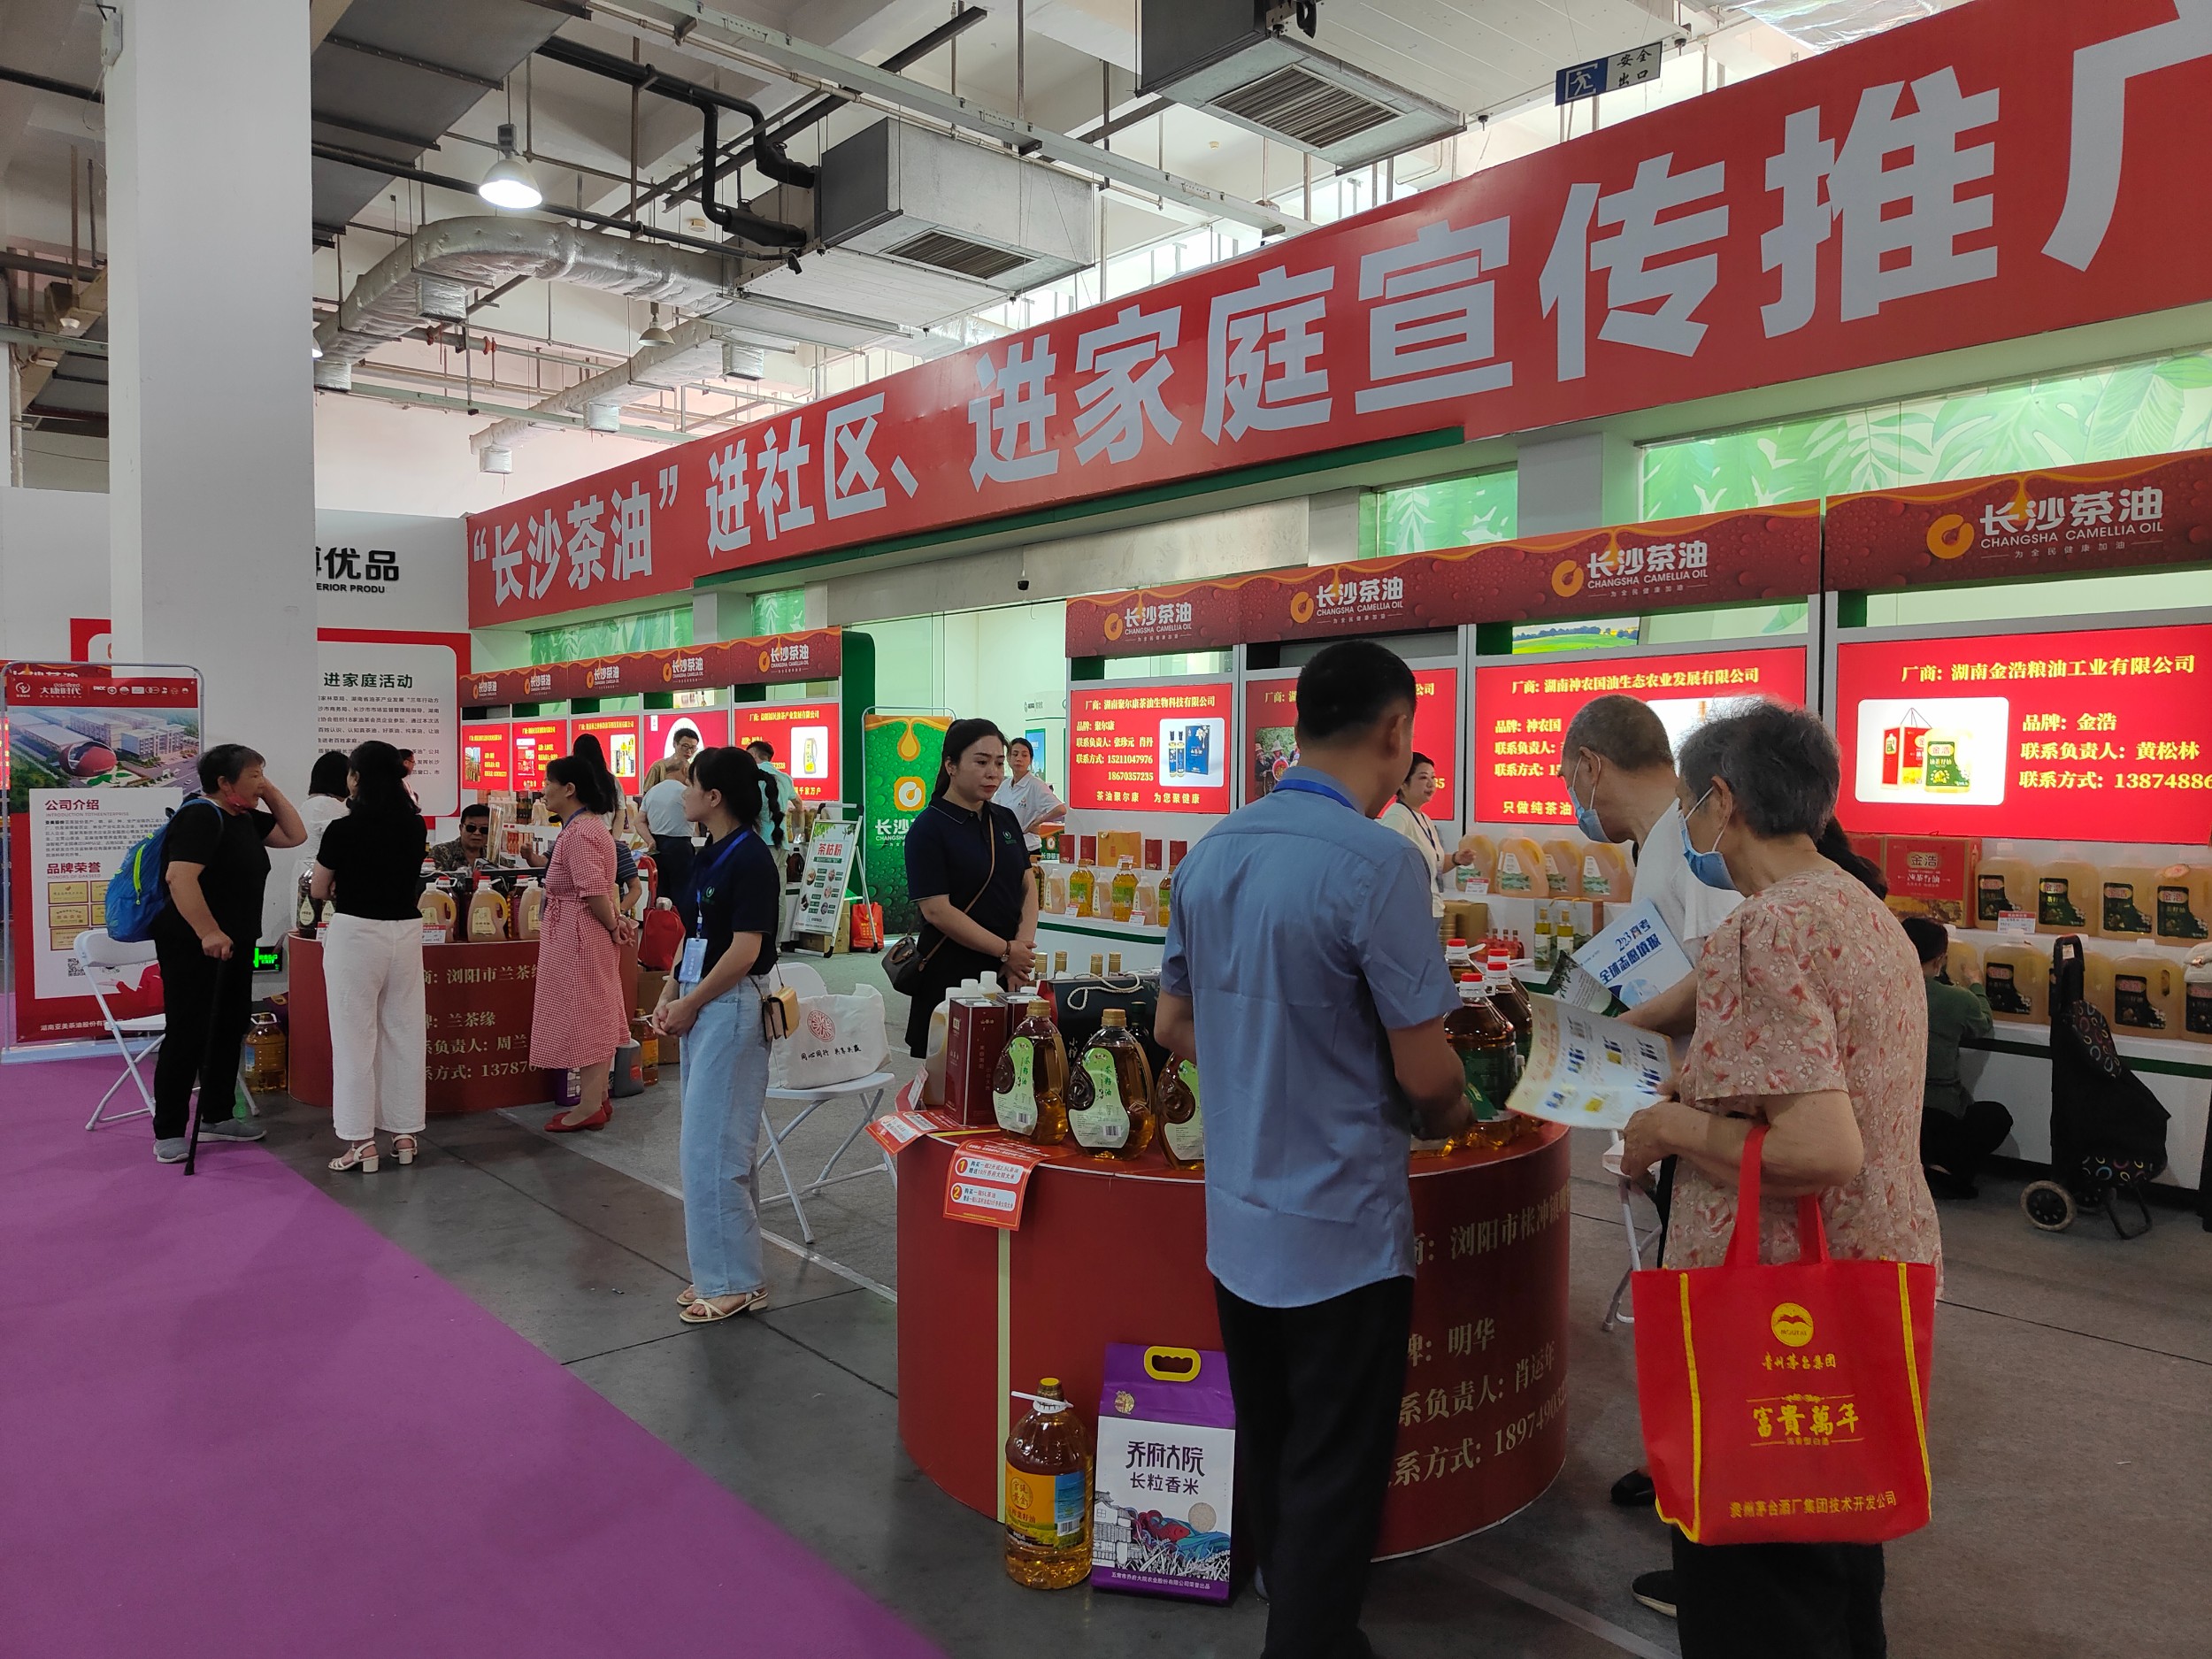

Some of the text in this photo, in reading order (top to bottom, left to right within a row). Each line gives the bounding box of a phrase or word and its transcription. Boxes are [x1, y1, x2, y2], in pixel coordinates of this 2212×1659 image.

[1617, 49, 1652, 67] 安全
[1618, 70, 1648, 87] 出口
[1980, 486, 2163, 535] 长沙茶油
[1981, 522, 2163, 549] CHANGSHA CAMELLIA OIL
[2015, 541, 2124, 557] 为全民健康加油
[1587, 541, 1708, 580] 长沙茶油
[1587, 569, 1708, 588] CHANGSHA CAMELLIA OIL
[1317, 577, 1403, 608] 长沙茶油
[1125, 602, 1192, 627] 长沙茶油
[1317, 607, 1354, 616] CHANGSHA
[1357, 603, 1390, 612] CAMELLIA
[770, 644, 809, 663] 长沙茶油
[594, 665, 619, 681] 长沙茶油
[672, 657, 703, 673] 长沙茶油
[324, 672, 412, 688] 进家庭活动
[1140, 737, 1154, 747] 肖丹
[1494, 741, 1564, 756] 联系负责人：
[1108, 772, 1154, 781] 18670357235
[45, 799, 99, 810] 公司介绍
[1096, 791, 1200, 803] 茶油聚尔康 为您聚健康
[1503, 801, 1572, 816] 只做纯茶油
[875, 818, 916, 835] 长沙
[818, 843, 842, 856] 茶枯粉
[47, 862, 101, 874] 品牌荣誉
[1911, 855, 1937, 866] 金浩
[959, 1160, 965, 1171] 1
[954, 1187, 959, 1198] 2
[1125, 1440, 1205, 1477] 乔府大院
[1130, 1471, 1199, 1495] 长粒香米
